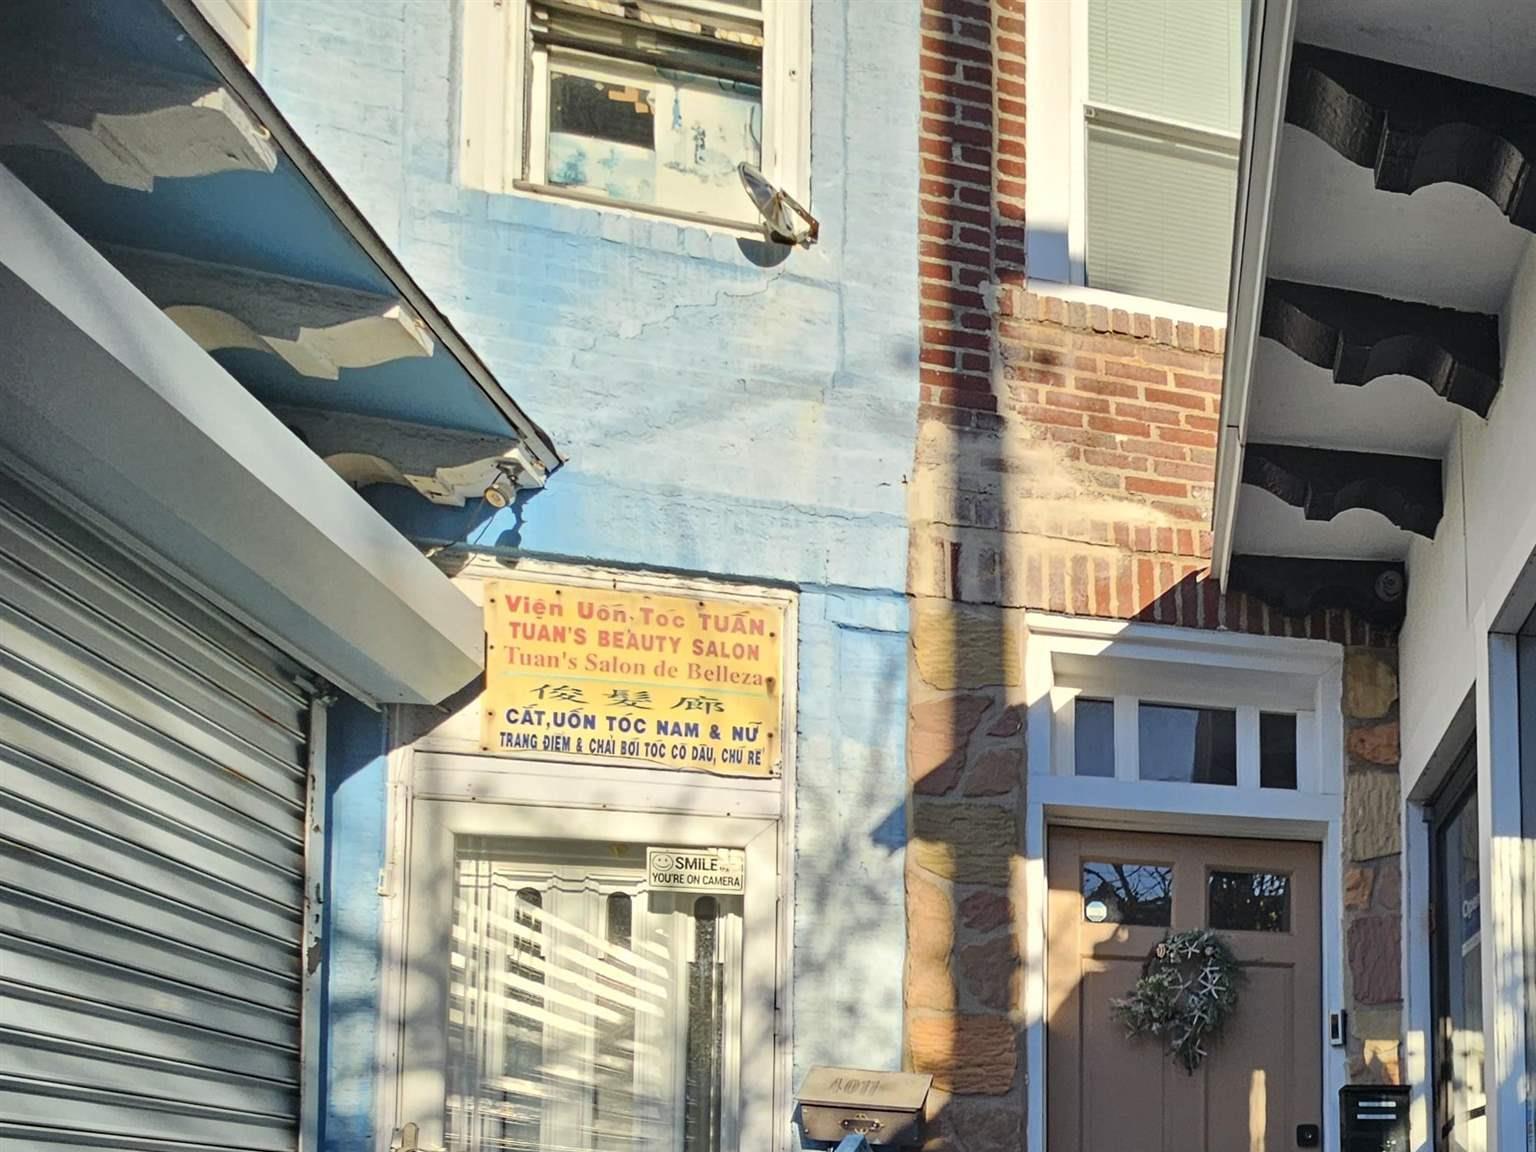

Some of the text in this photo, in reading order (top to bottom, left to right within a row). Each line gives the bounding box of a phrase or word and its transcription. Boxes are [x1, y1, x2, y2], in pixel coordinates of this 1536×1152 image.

[509, 622, 760, 662] TUAN'S BEAUTY SALON
[504, 646, 764, 687] Tuan's Salon de Belleza
[656, 720, 700, 739] NAM
[709, 724, 722, 740] &
[500, 732, 538, 750] TRANG
[576, 737, 584, 752] &
[675, 856, 718, 871] SMILE
[652, 872, 740, 887] YOU'RE ON CAMERA
